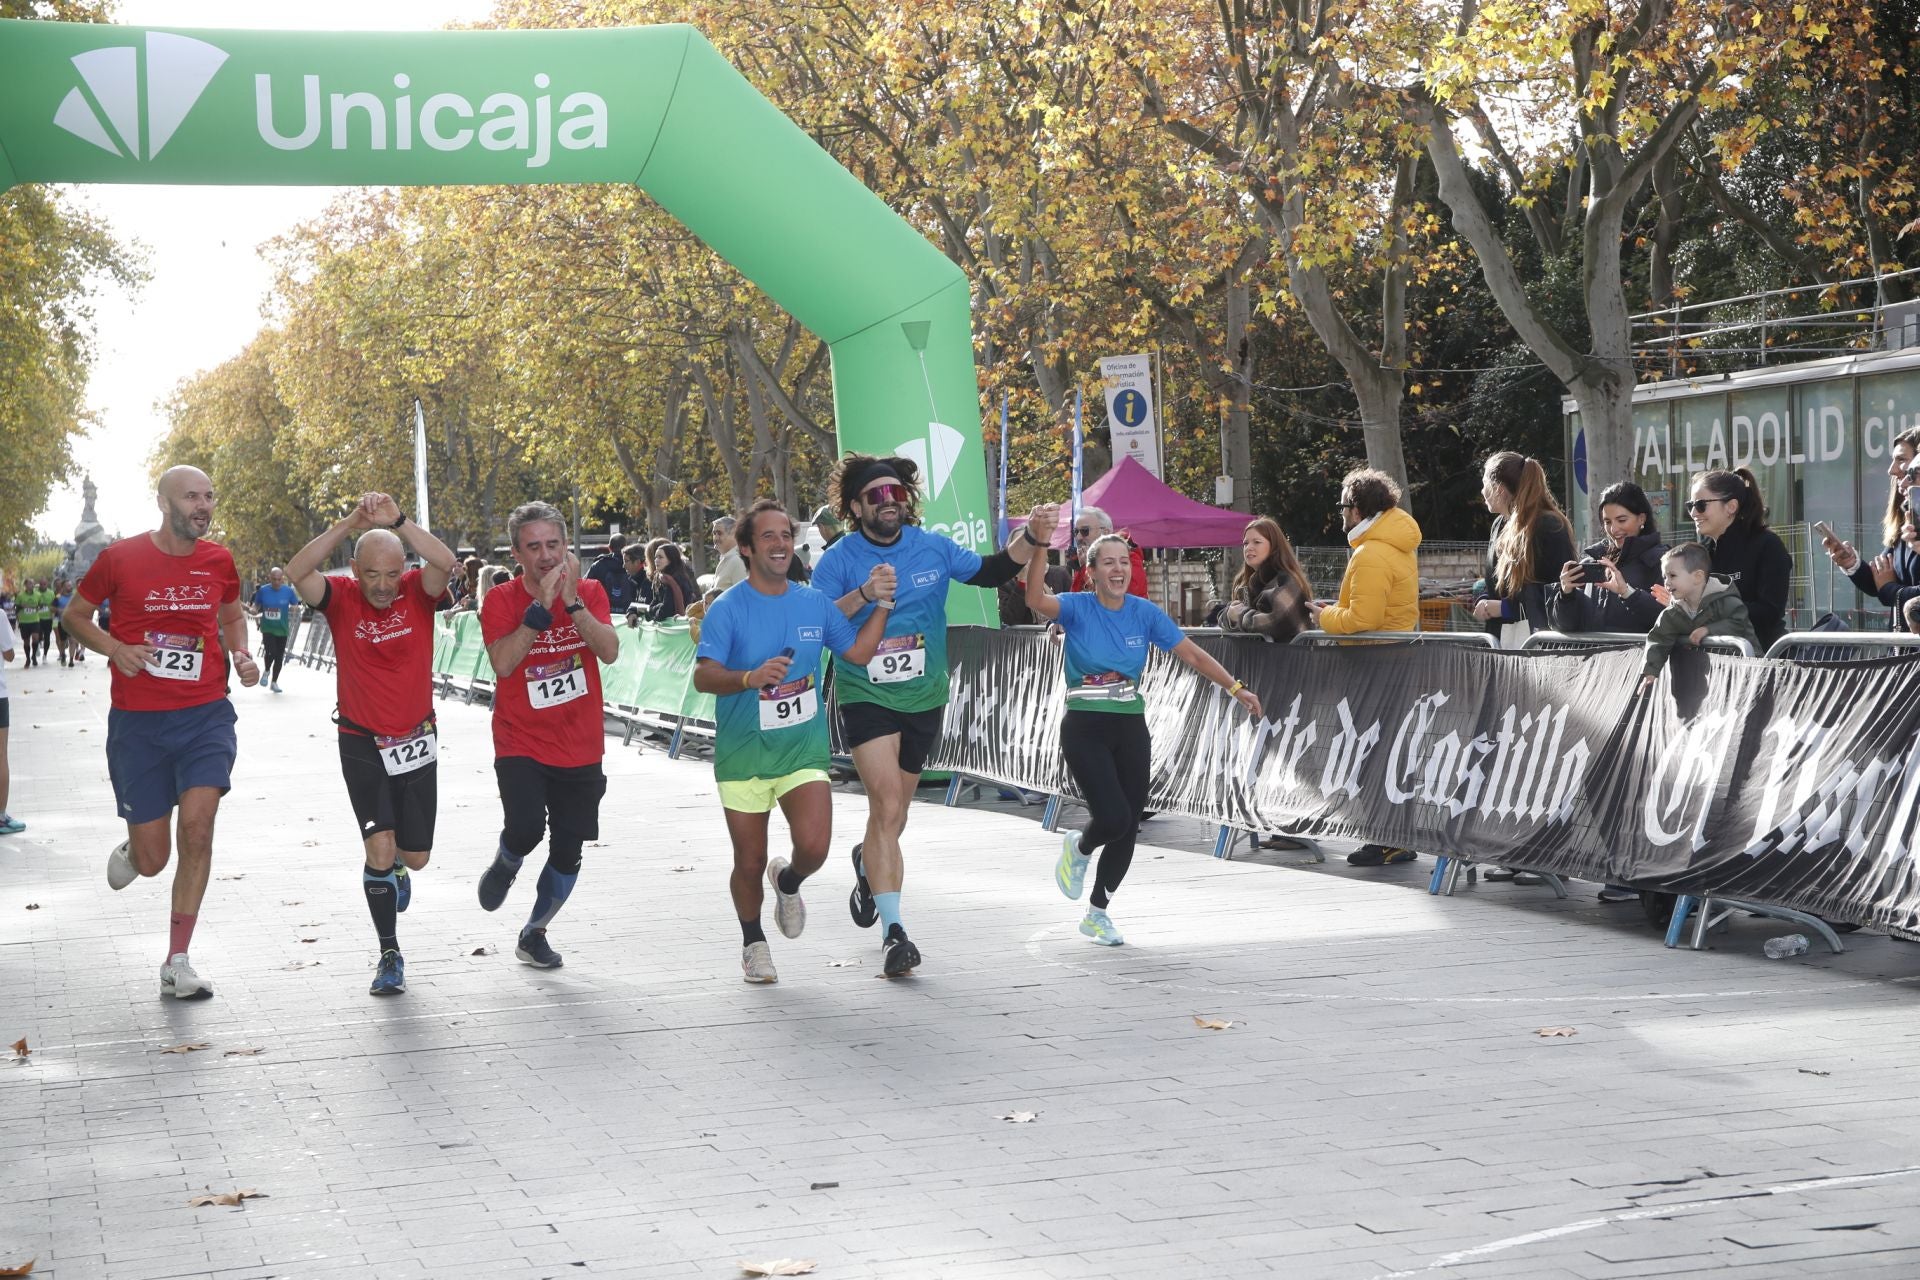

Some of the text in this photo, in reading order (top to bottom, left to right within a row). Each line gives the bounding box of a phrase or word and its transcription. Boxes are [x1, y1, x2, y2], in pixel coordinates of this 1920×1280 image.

[255, 72, 608, 168] Unicaja
[144, 604, 169, 612] Sports
[556, 641, 587, 652] Santande
[152, 649, 195, 672] 123
[882, 653, 912, 674] 92
[537, 673, 576, 699] 121
[776, 697, 802, 719] 91
[389, 739, 430, 766] 122
[1319, 697, 1380, 800] de
[1384, 689, 1591, 826] Castilla
[1644, 708, 1738, 853] El
